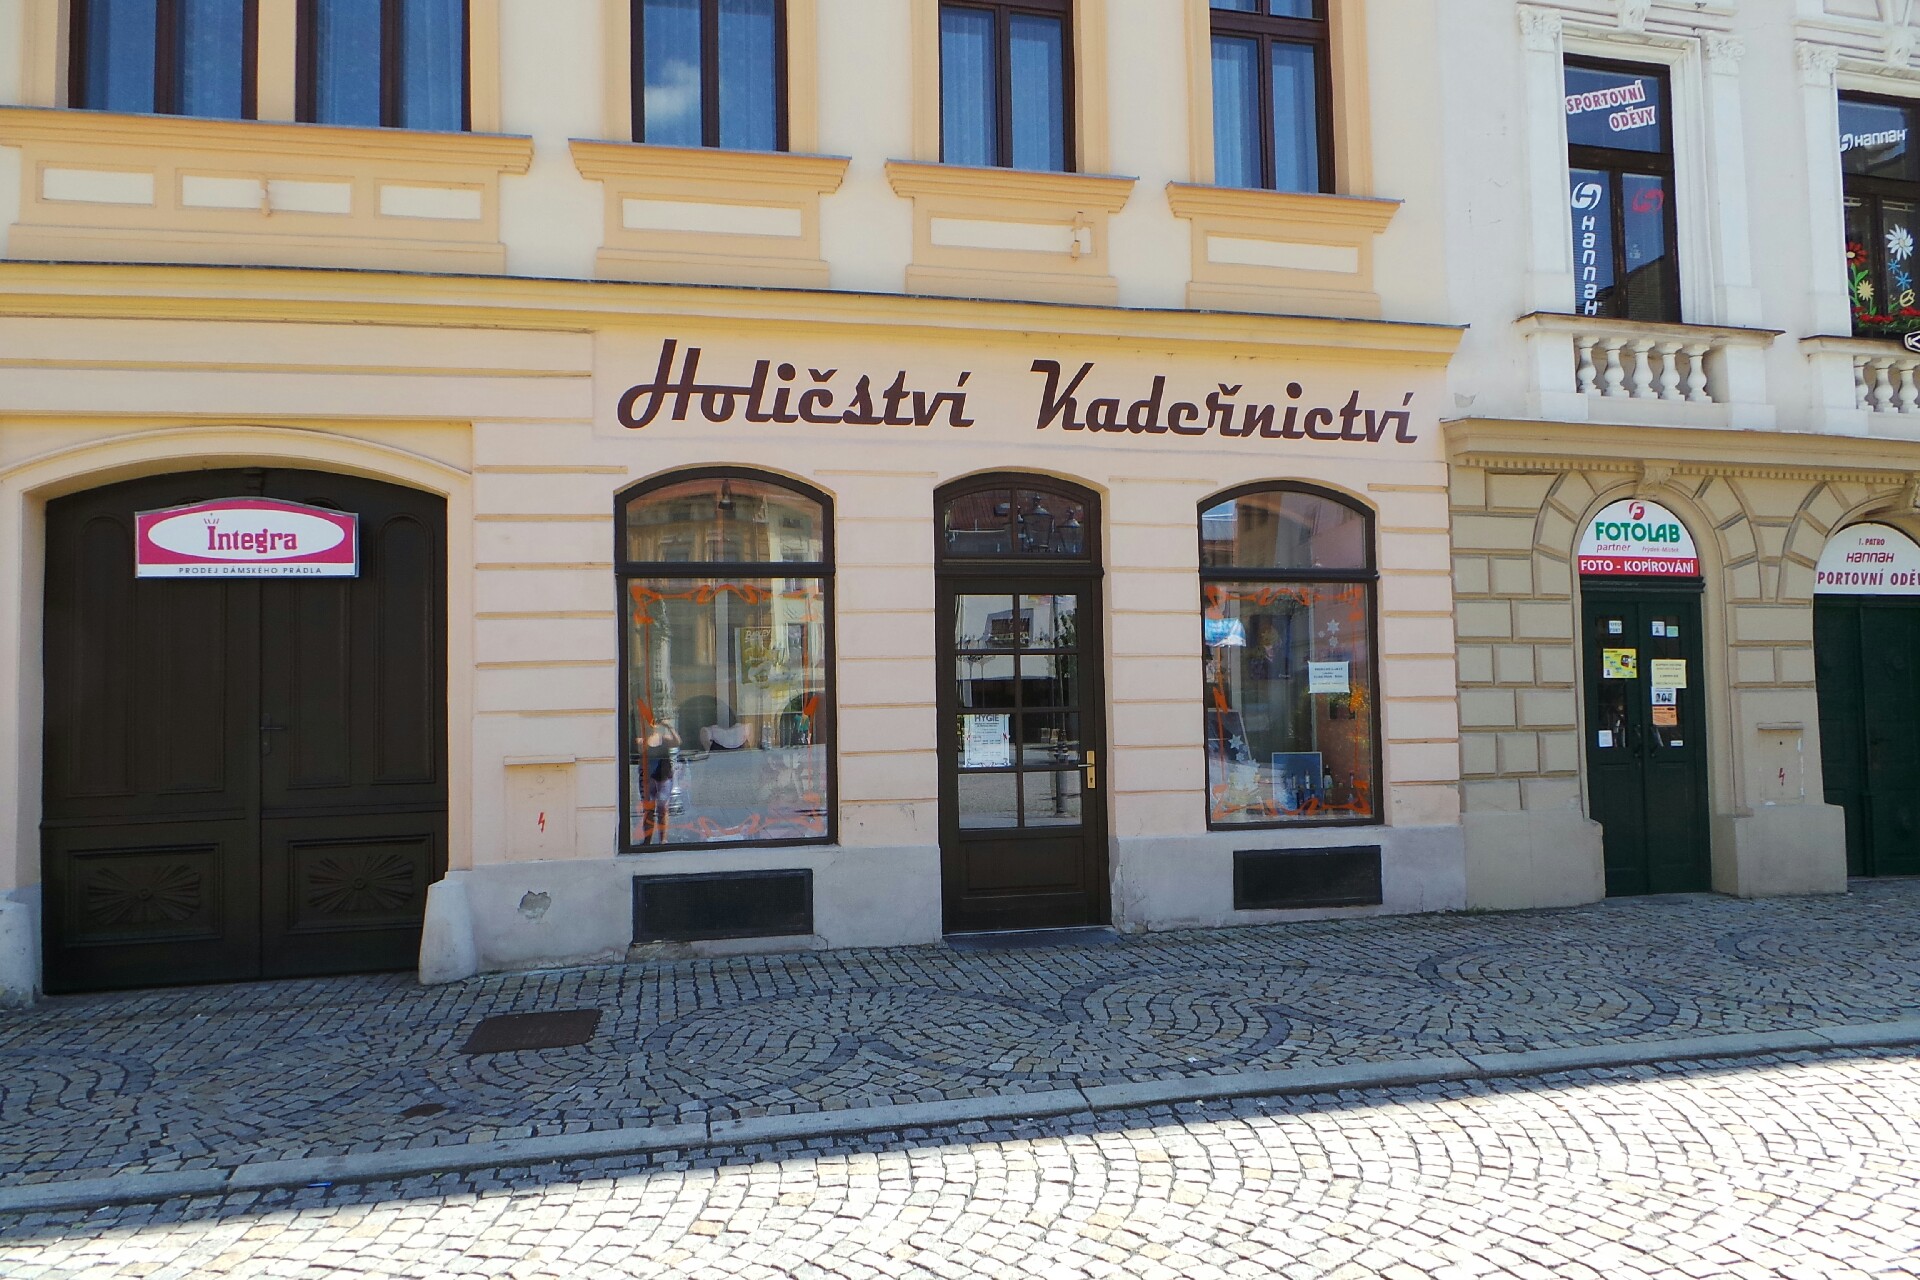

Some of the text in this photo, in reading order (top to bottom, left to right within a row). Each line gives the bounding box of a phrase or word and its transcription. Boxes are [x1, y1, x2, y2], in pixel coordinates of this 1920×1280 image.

[1566, 80, 1644, 113] SPORTOVNÍ
[1609, 106, 1655, 131] ODĚVY
[617, 338, 1418, 444] Holičství Kadeřnictví
[207, 525, 298, 554] Integra
[1595, 522, 1680, 543] FOTOLAB
[1865, 538, 1885, 546] PATRO
[1596, 543, 1631, 553] partner
[223, 566, 278, 574] DÁMSKÉHO
[283, 565, 322, 574] PRÁDLA
[1581, 560, 1613, 571] FOTO
[1624, 559, 1694, 573] KOPÍROVÁNÍ
[1818, 568, 1884, 586] PORTOVNÍ
